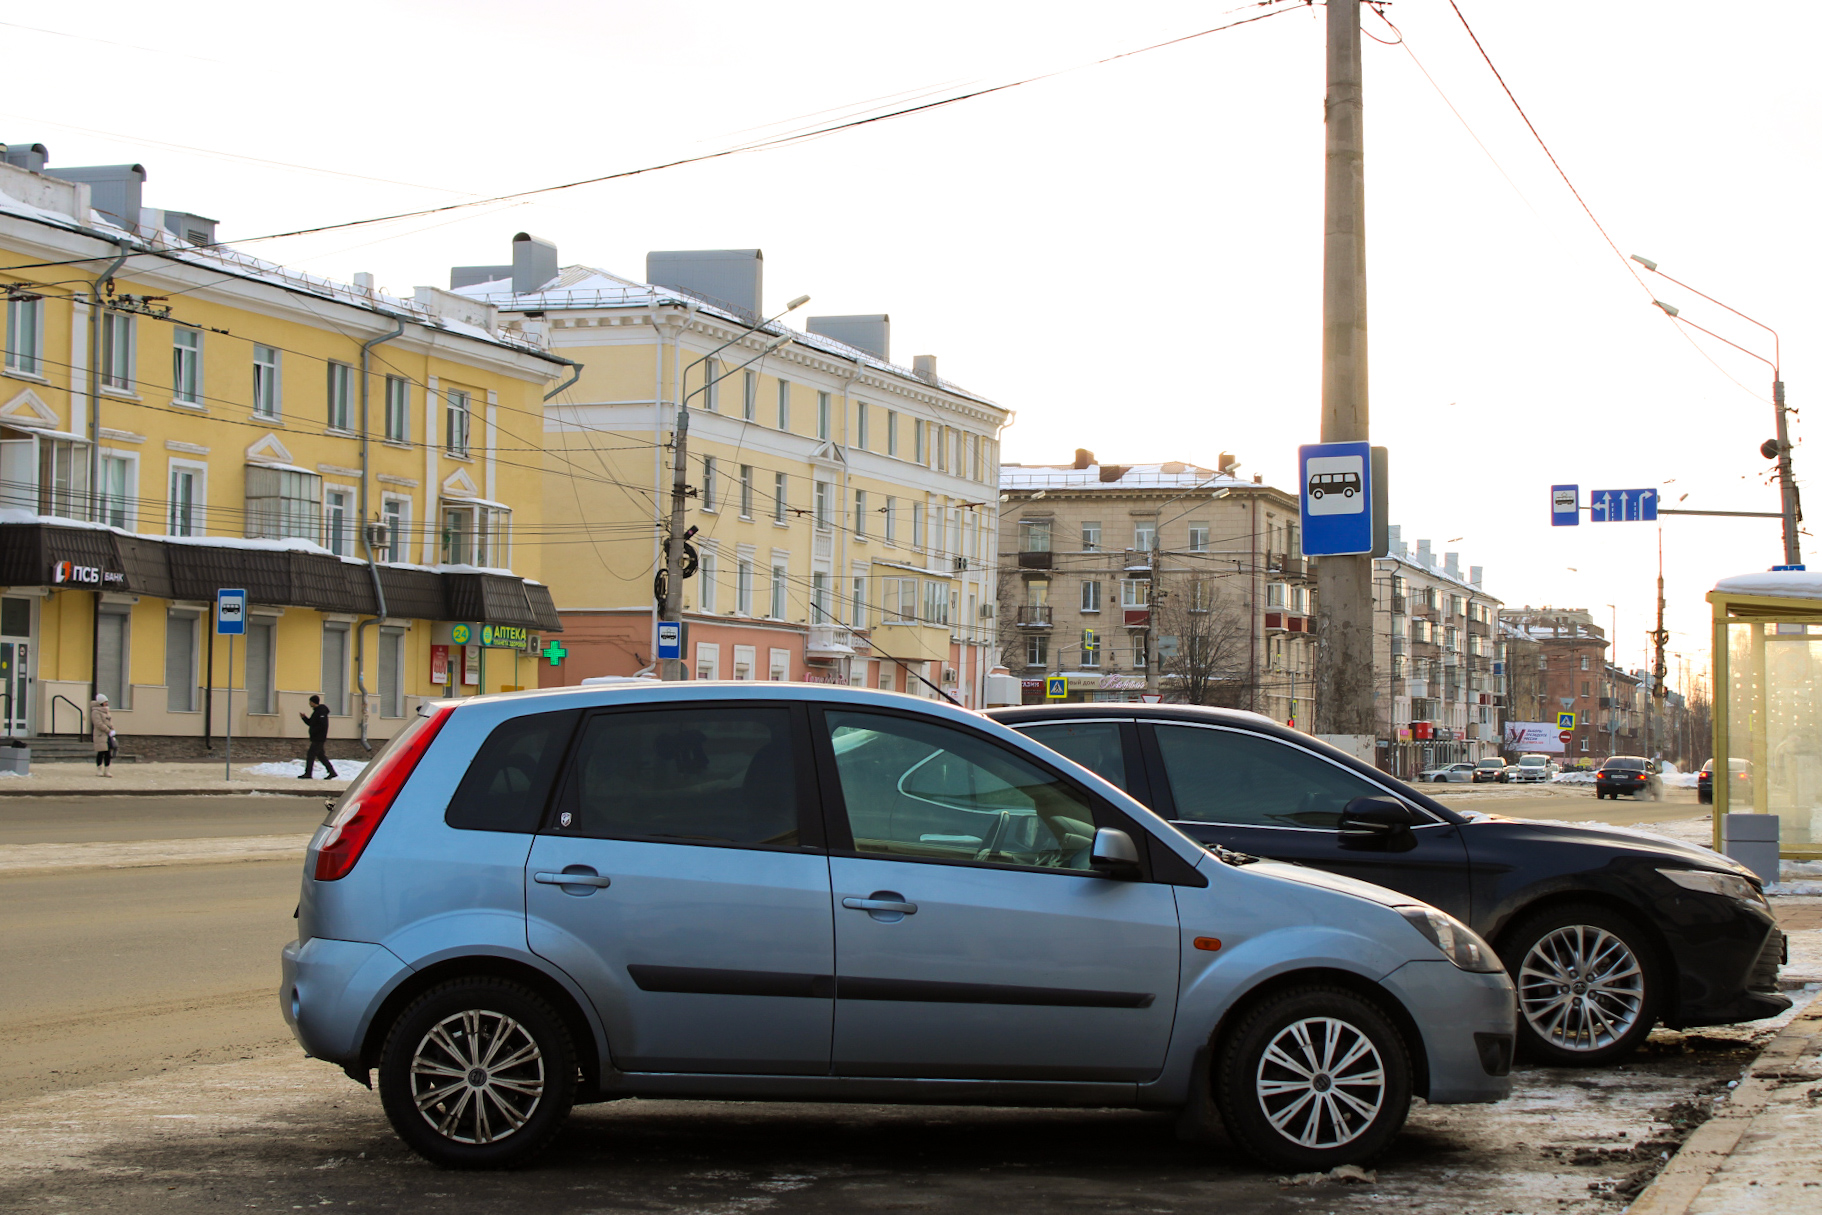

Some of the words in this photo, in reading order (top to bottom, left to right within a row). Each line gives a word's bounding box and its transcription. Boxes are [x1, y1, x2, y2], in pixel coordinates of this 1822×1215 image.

[73, 566, 99, 582] ПСБ
[104, 572, 124, 582] БАНК
[494, 626, 527, 640] АПТЕКА
